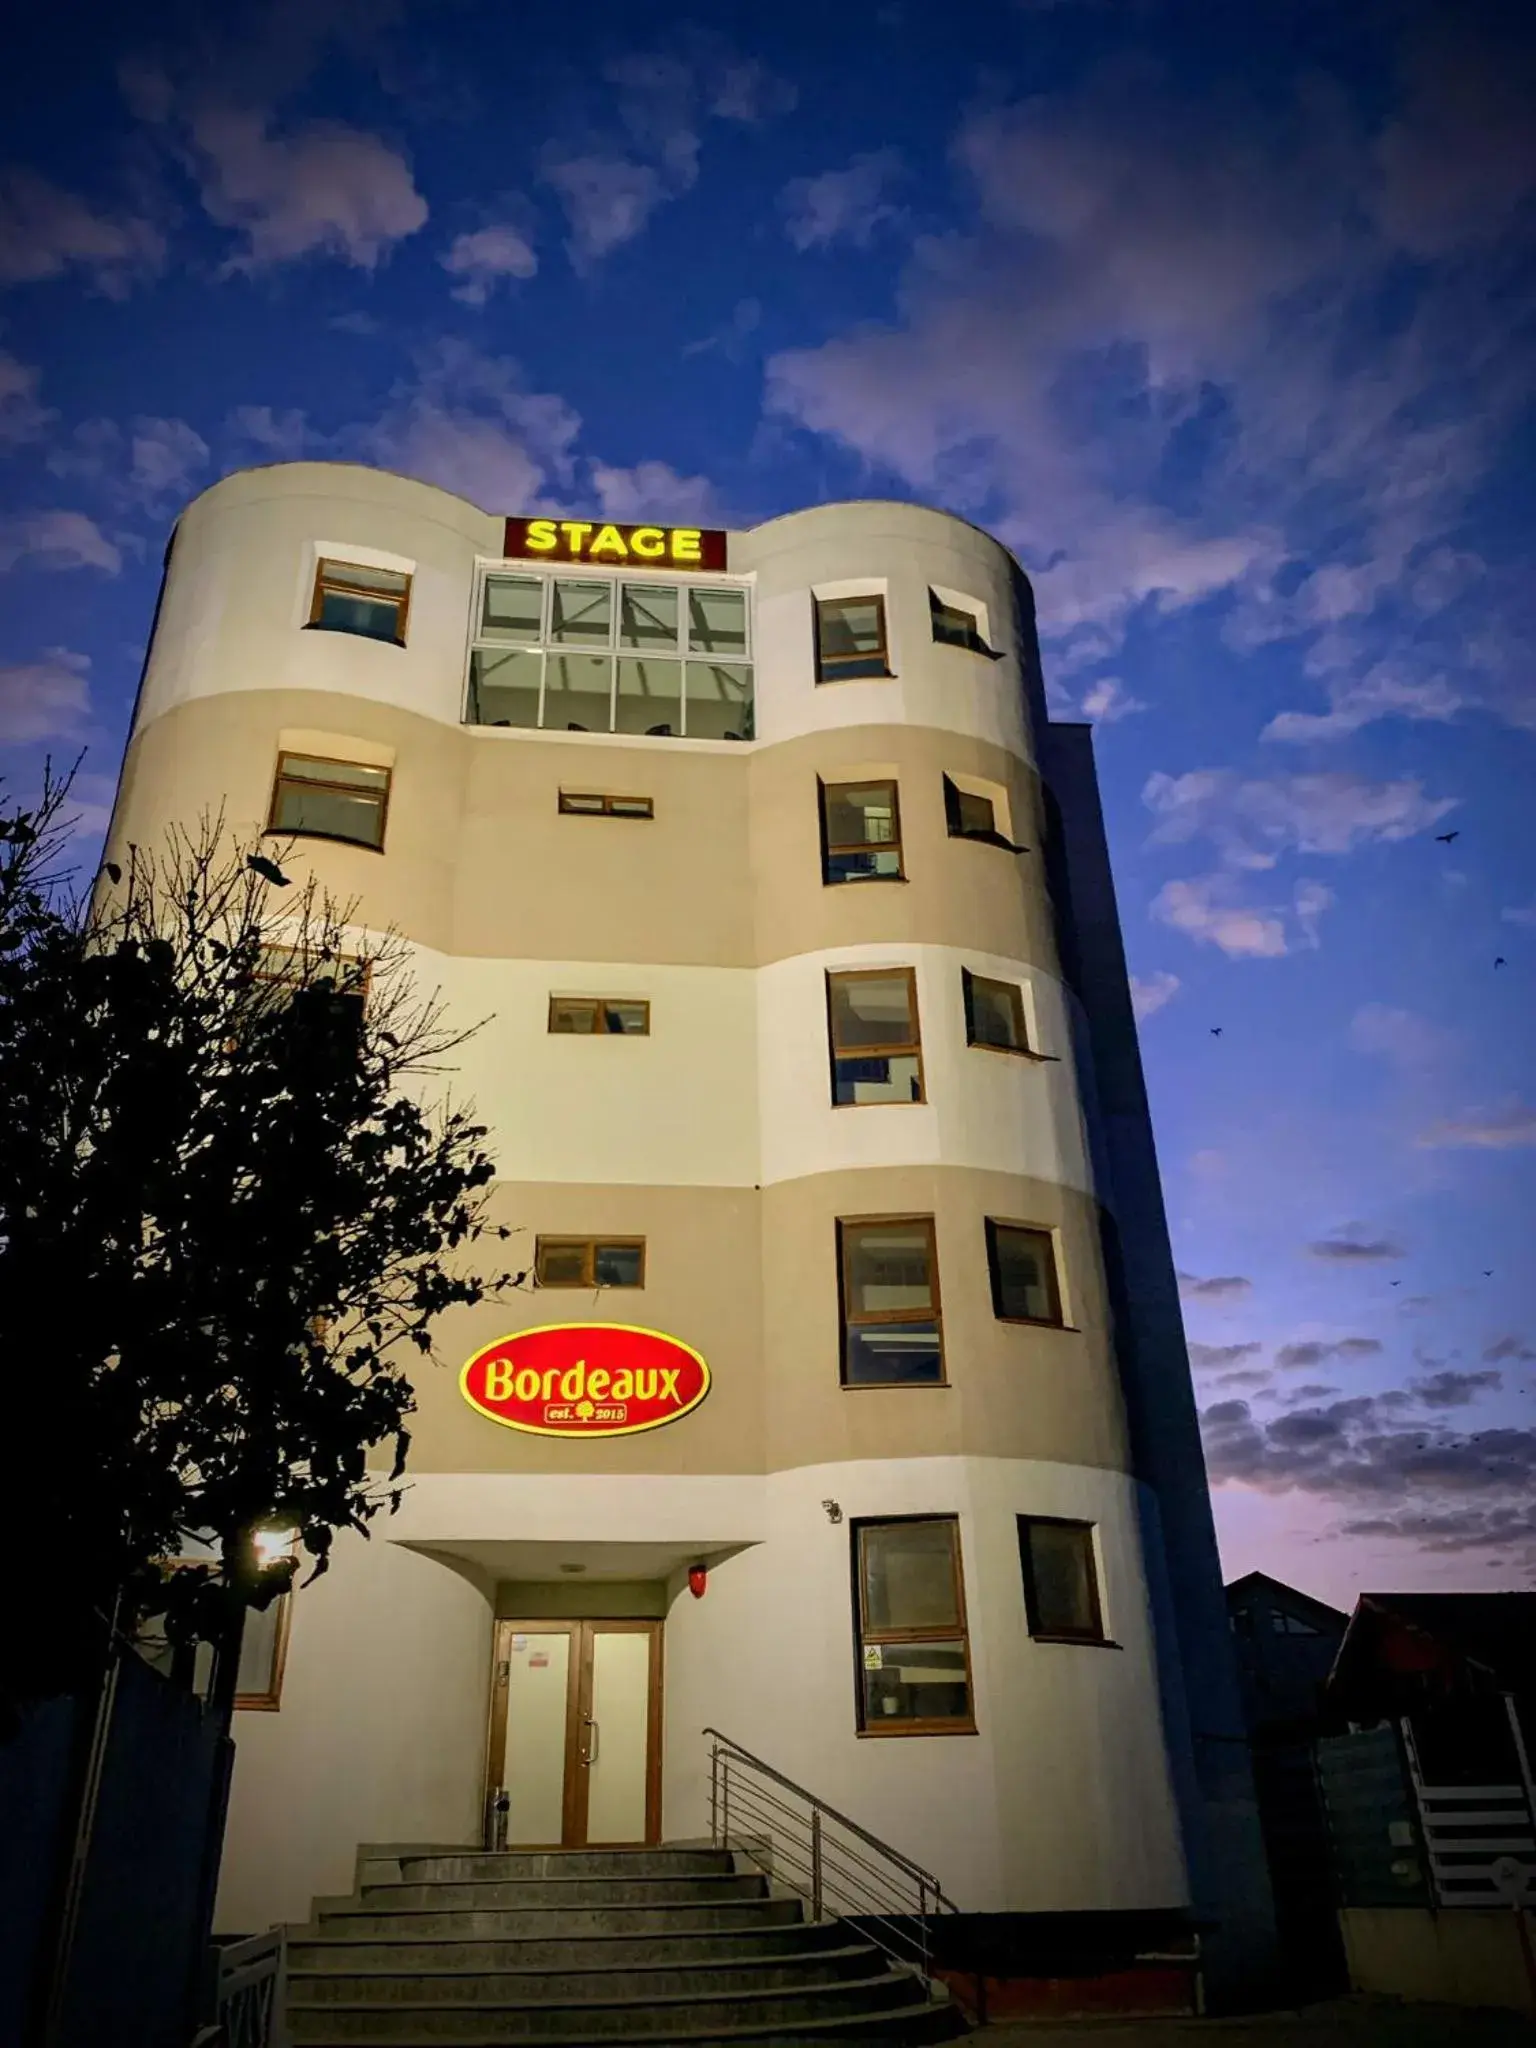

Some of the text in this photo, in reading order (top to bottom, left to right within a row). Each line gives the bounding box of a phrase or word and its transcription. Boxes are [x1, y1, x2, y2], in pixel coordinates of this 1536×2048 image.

[525, 521, 702, 560] STAGE
[485, 1358, 682, 1405] Bordeaux
[548, 1407, 625, 1421] est. 2015
